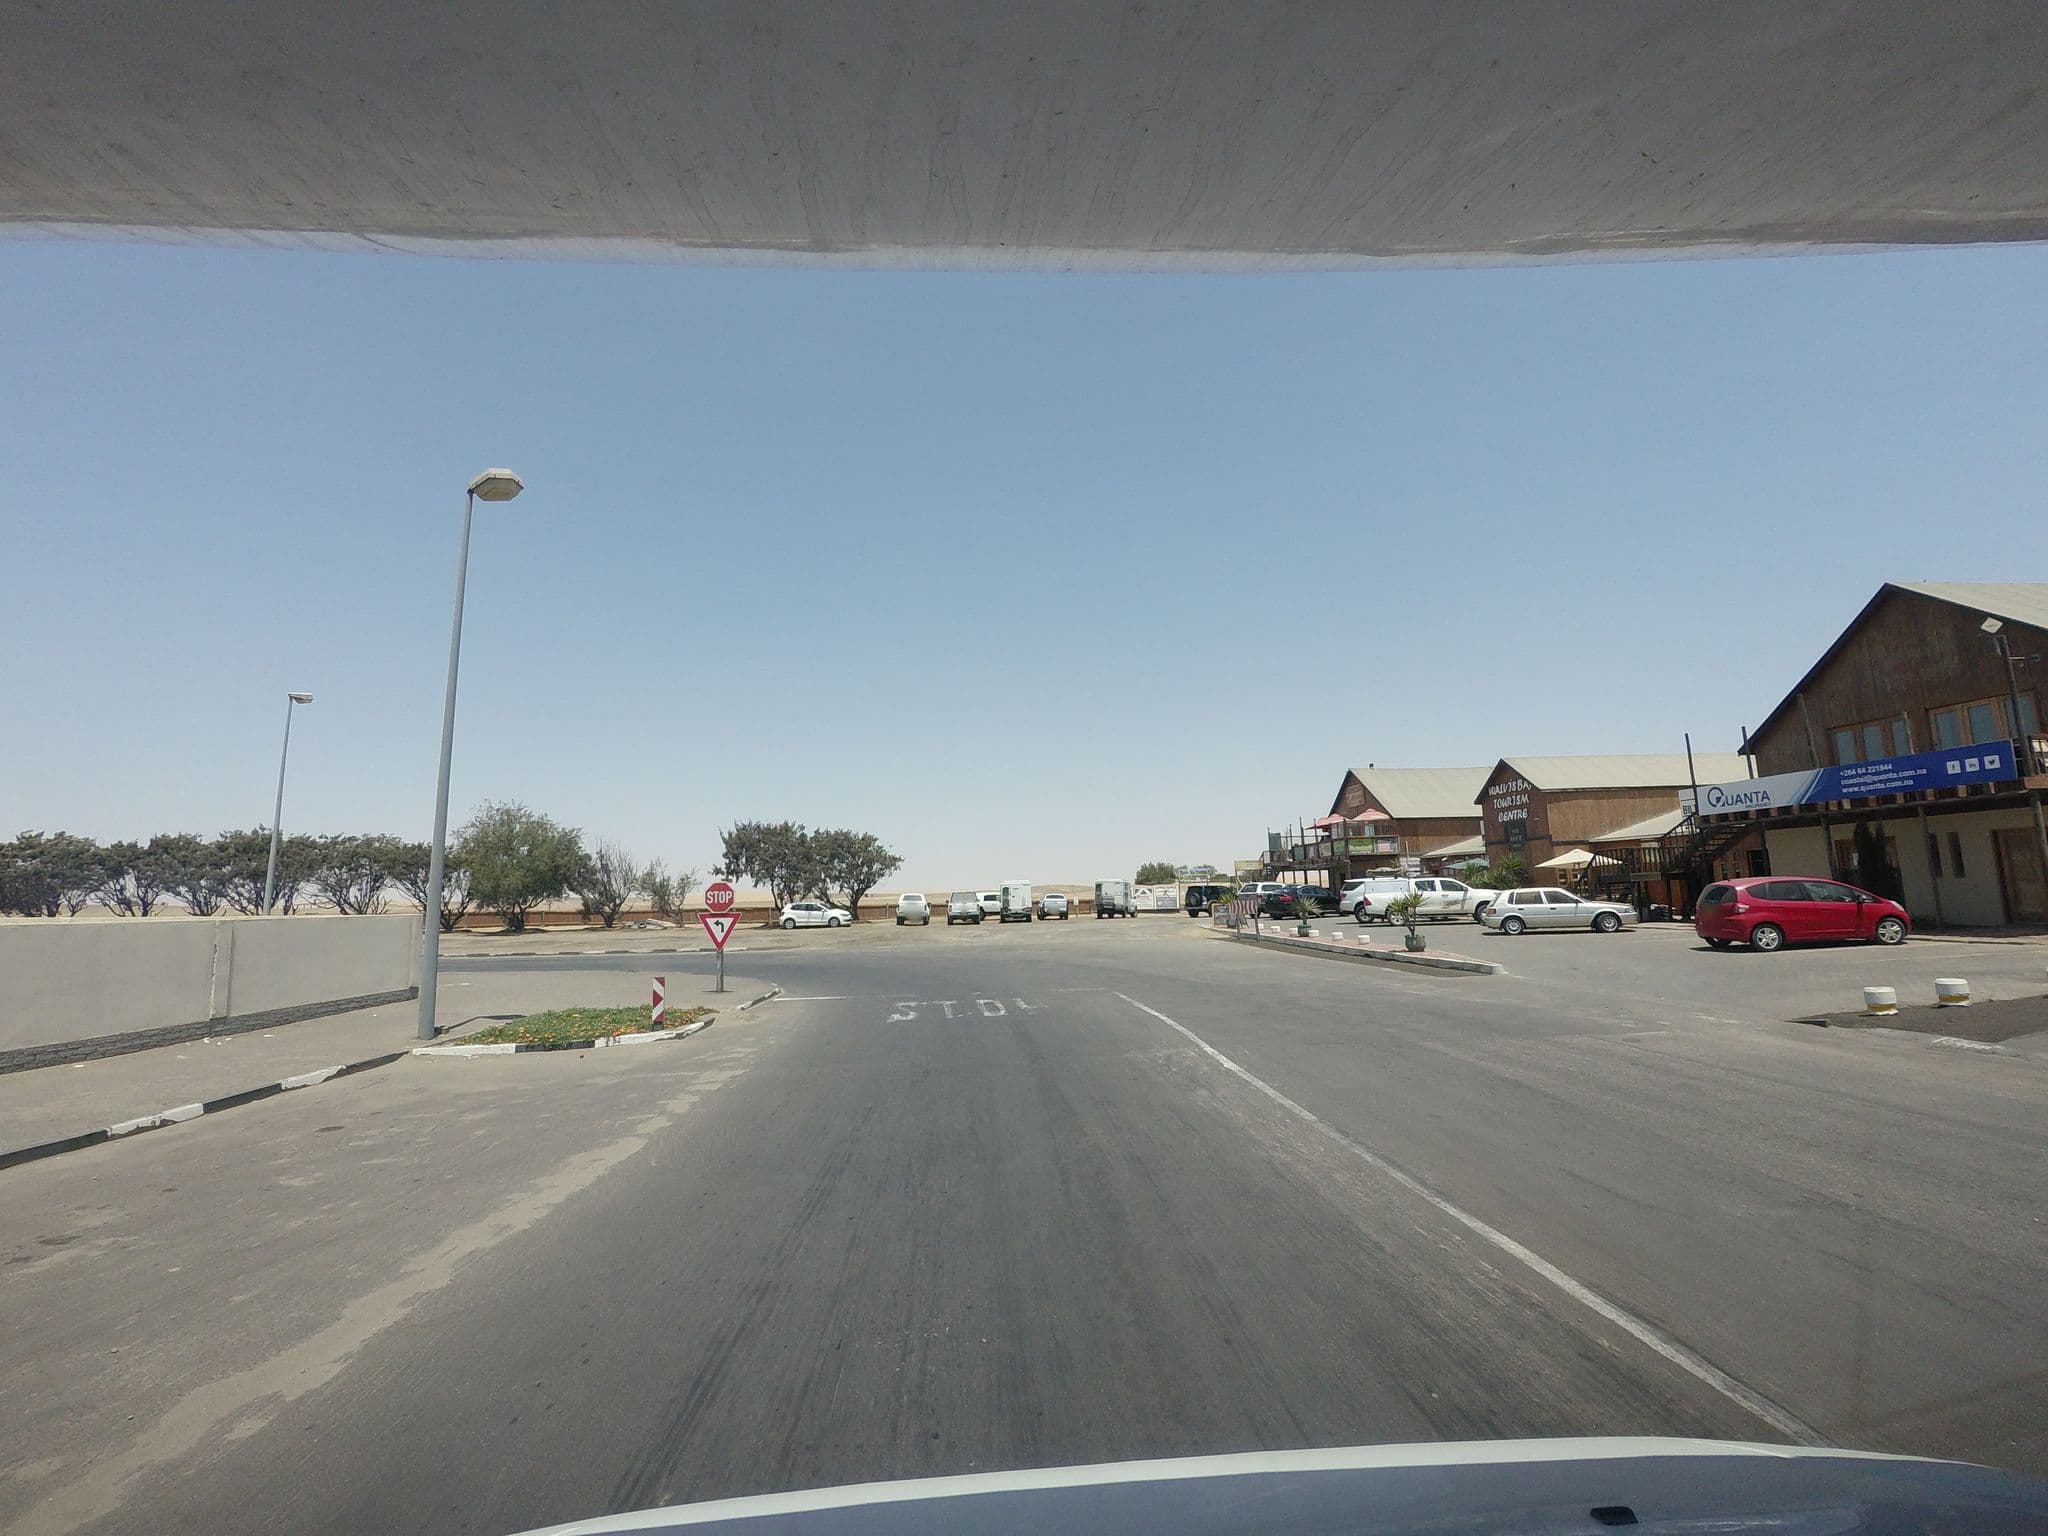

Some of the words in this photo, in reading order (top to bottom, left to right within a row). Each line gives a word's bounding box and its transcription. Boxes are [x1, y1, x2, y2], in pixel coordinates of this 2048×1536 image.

[1493, 794, 1530, 809] TOURISM
[1707, 786, 1771, 808] QUANTA
[1498, 808, 1528, 822] CENTRE
[706, 890, 732, 904] STOP
